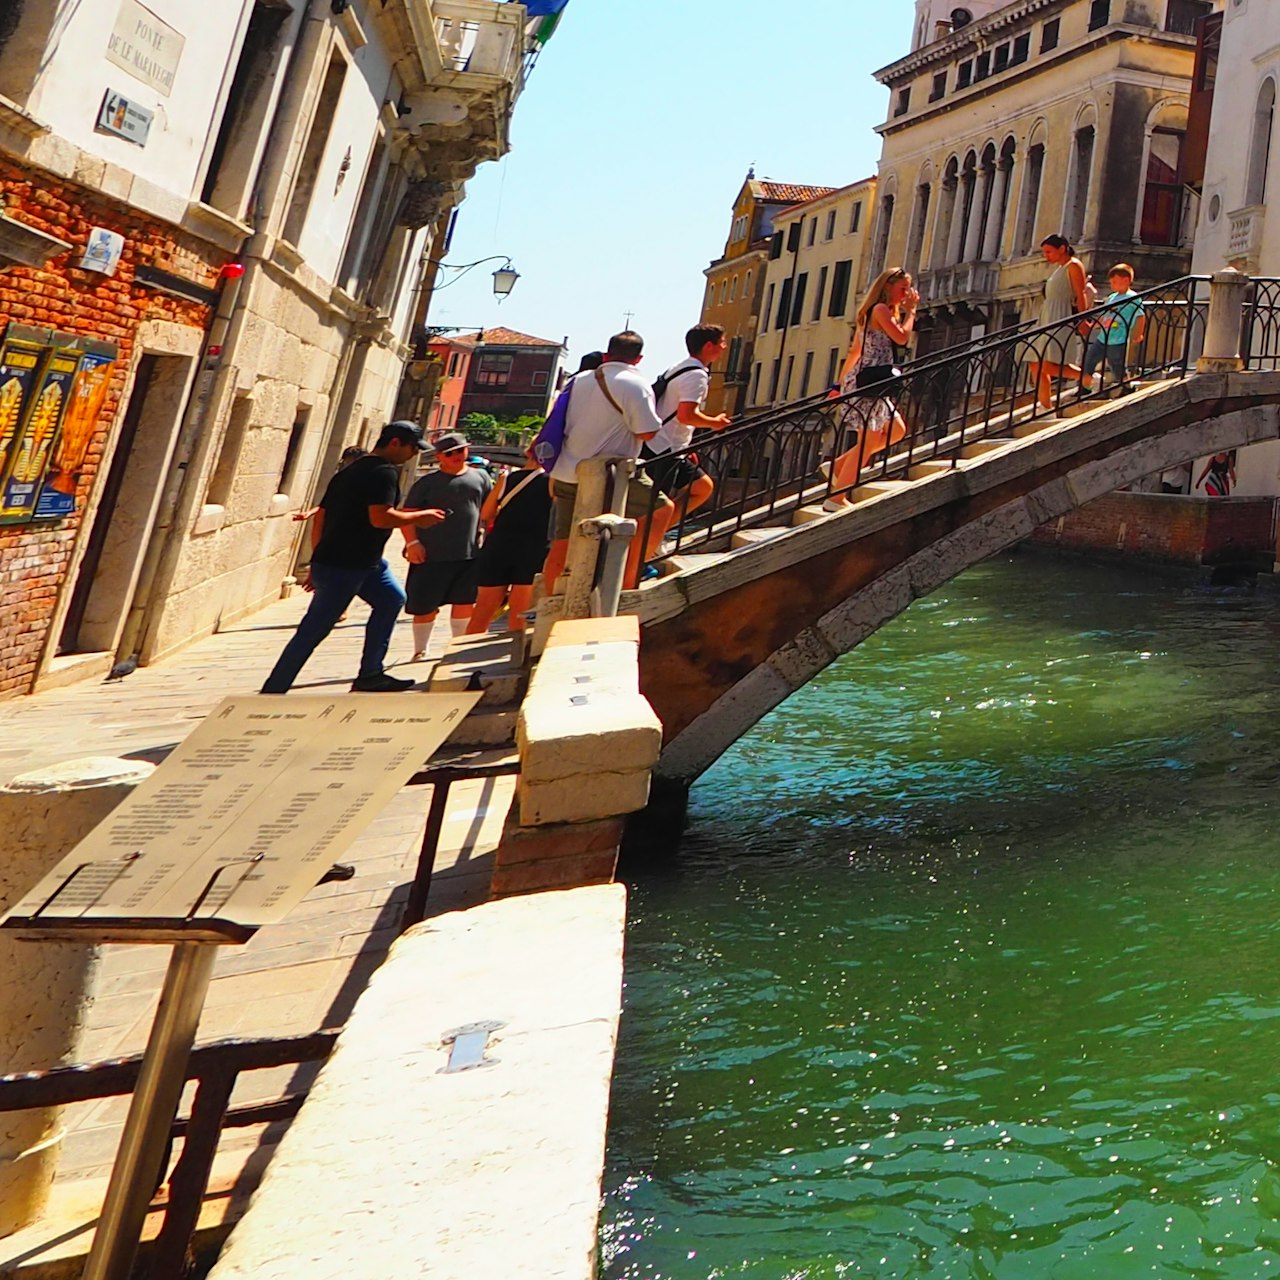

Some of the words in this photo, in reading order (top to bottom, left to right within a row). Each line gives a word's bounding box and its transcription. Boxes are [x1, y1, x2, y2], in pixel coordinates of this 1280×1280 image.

[108, 32, 121, 54] DE
[121, 41, 133, 62] LE
[135, 19, 163, 51] PONTE
